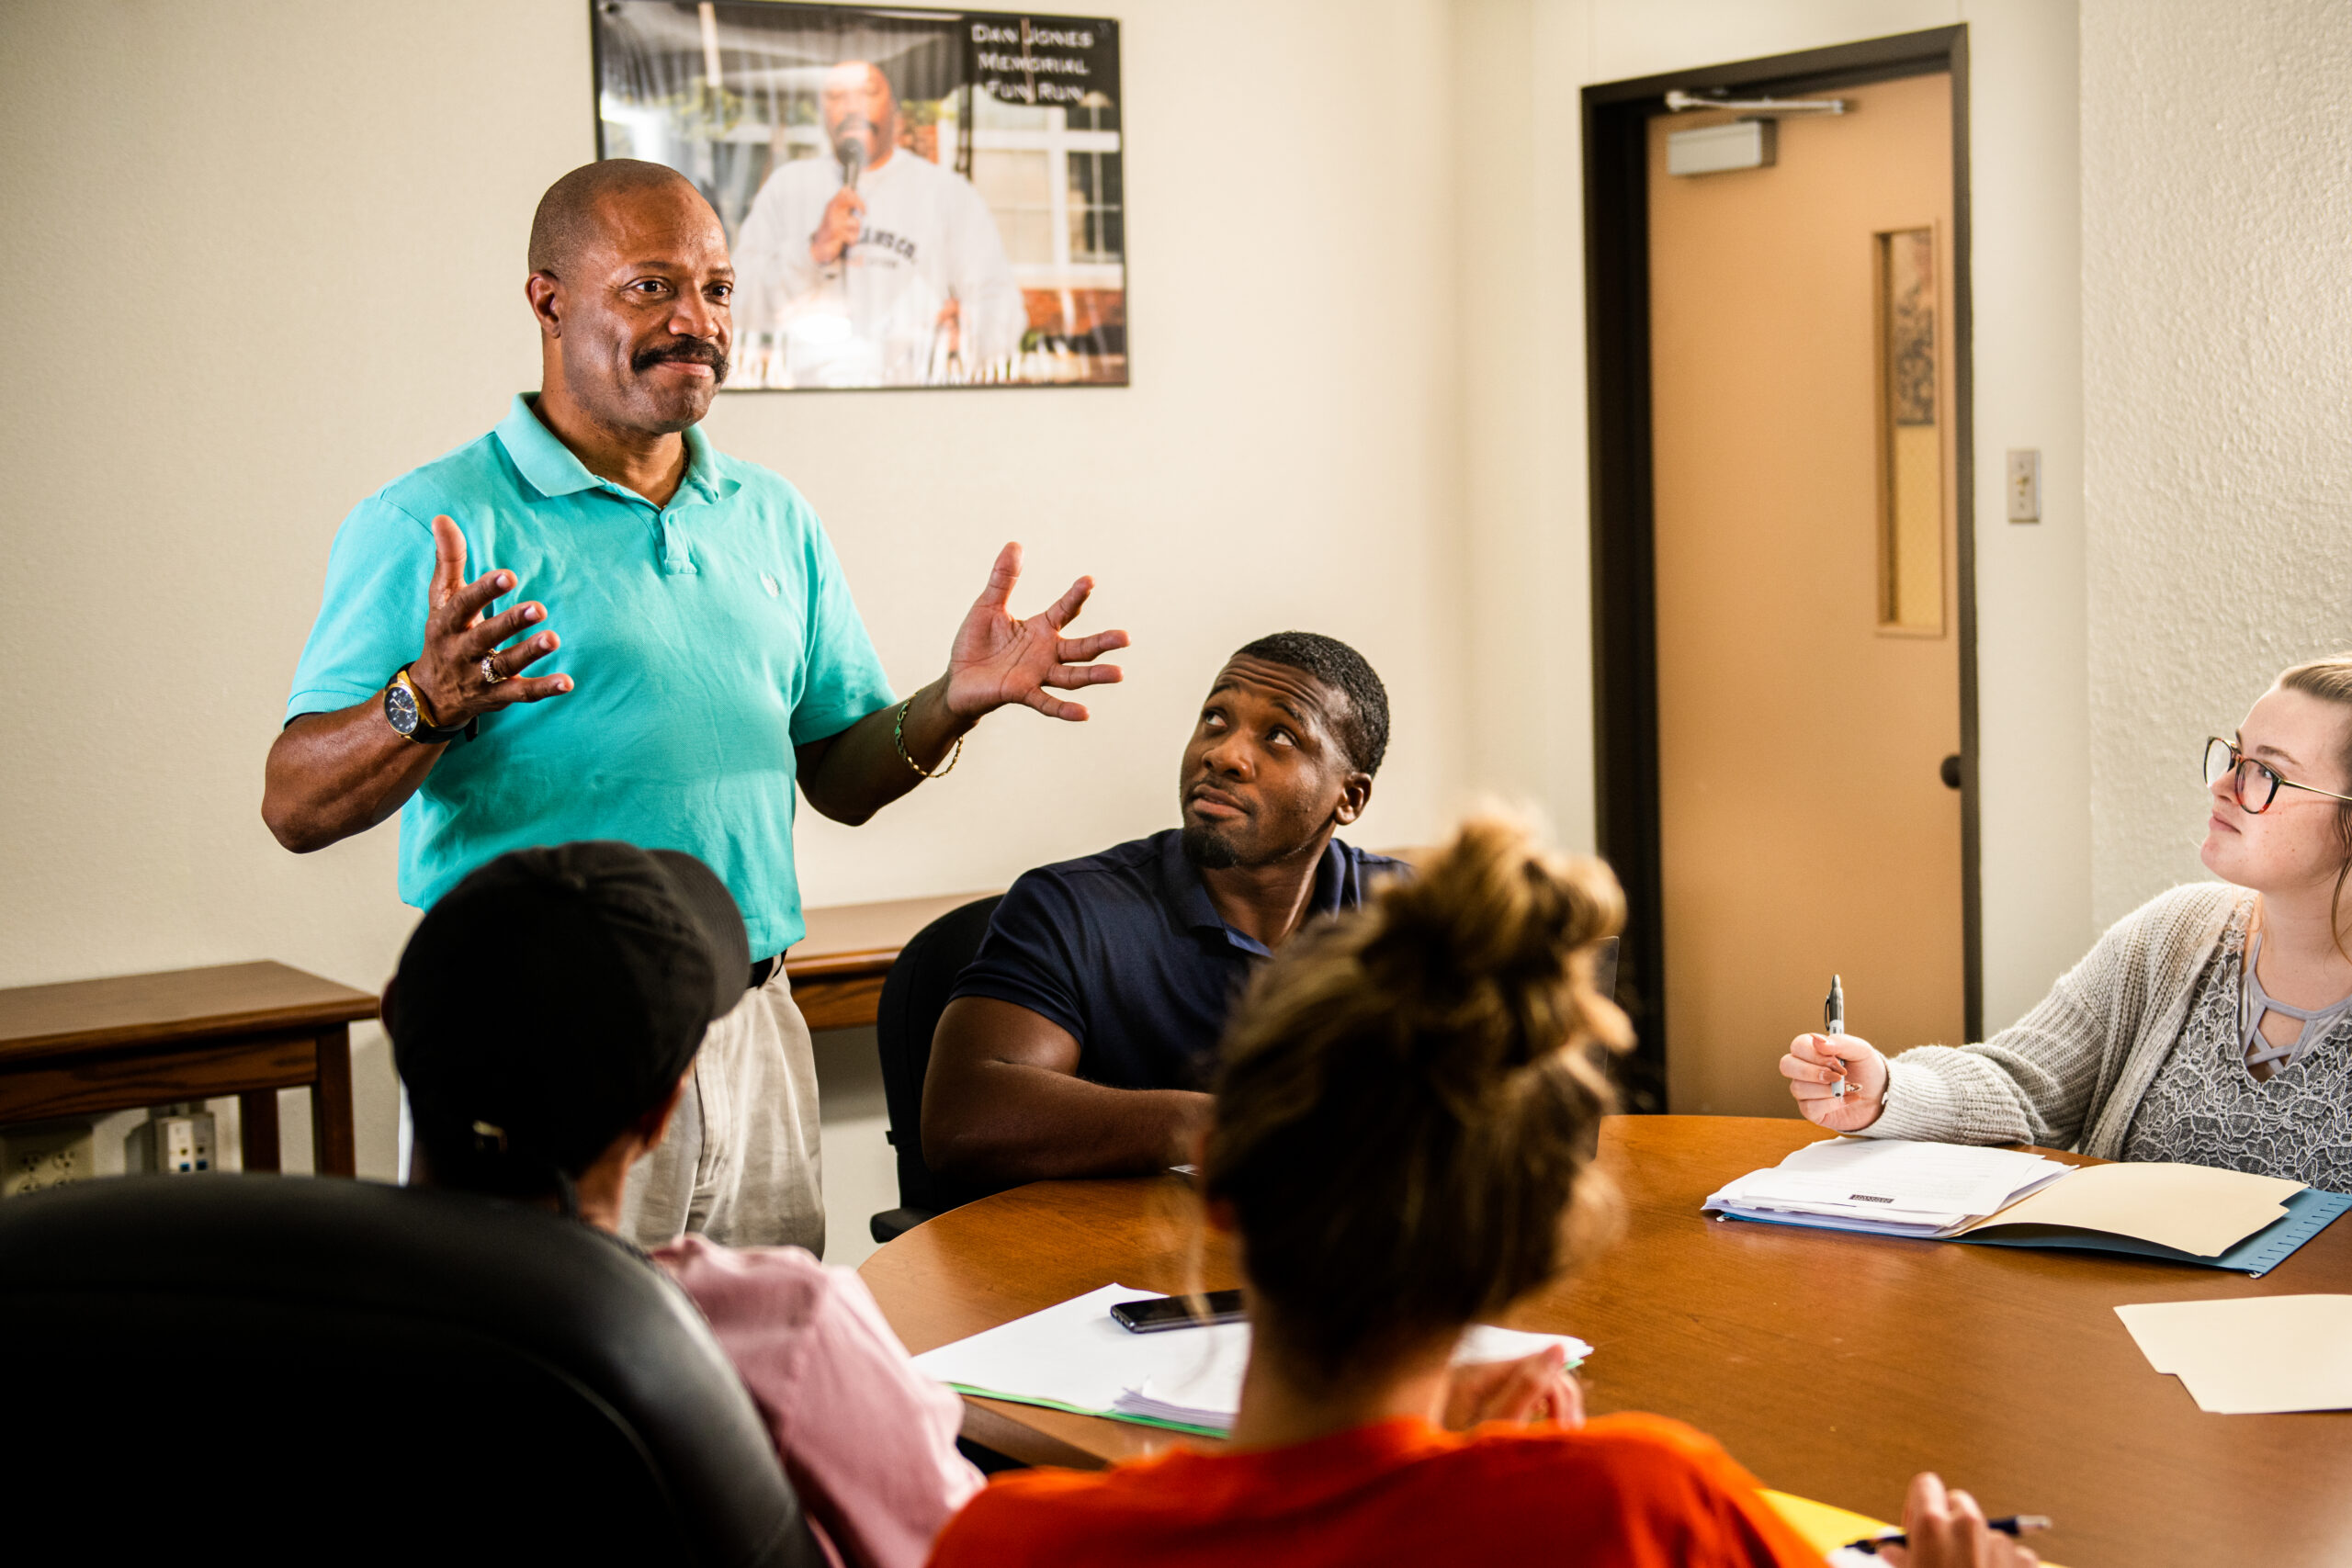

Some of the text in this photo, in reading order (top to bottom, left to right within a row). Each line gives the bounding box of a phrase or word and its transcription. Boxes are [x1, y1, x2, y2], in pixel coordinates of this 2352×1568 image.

[970, 23, 1095, 49] DAN JONES
[978, 51, 1091, 76] MEMORIAL
[986, 79, 1085, 102] FUN RUN
